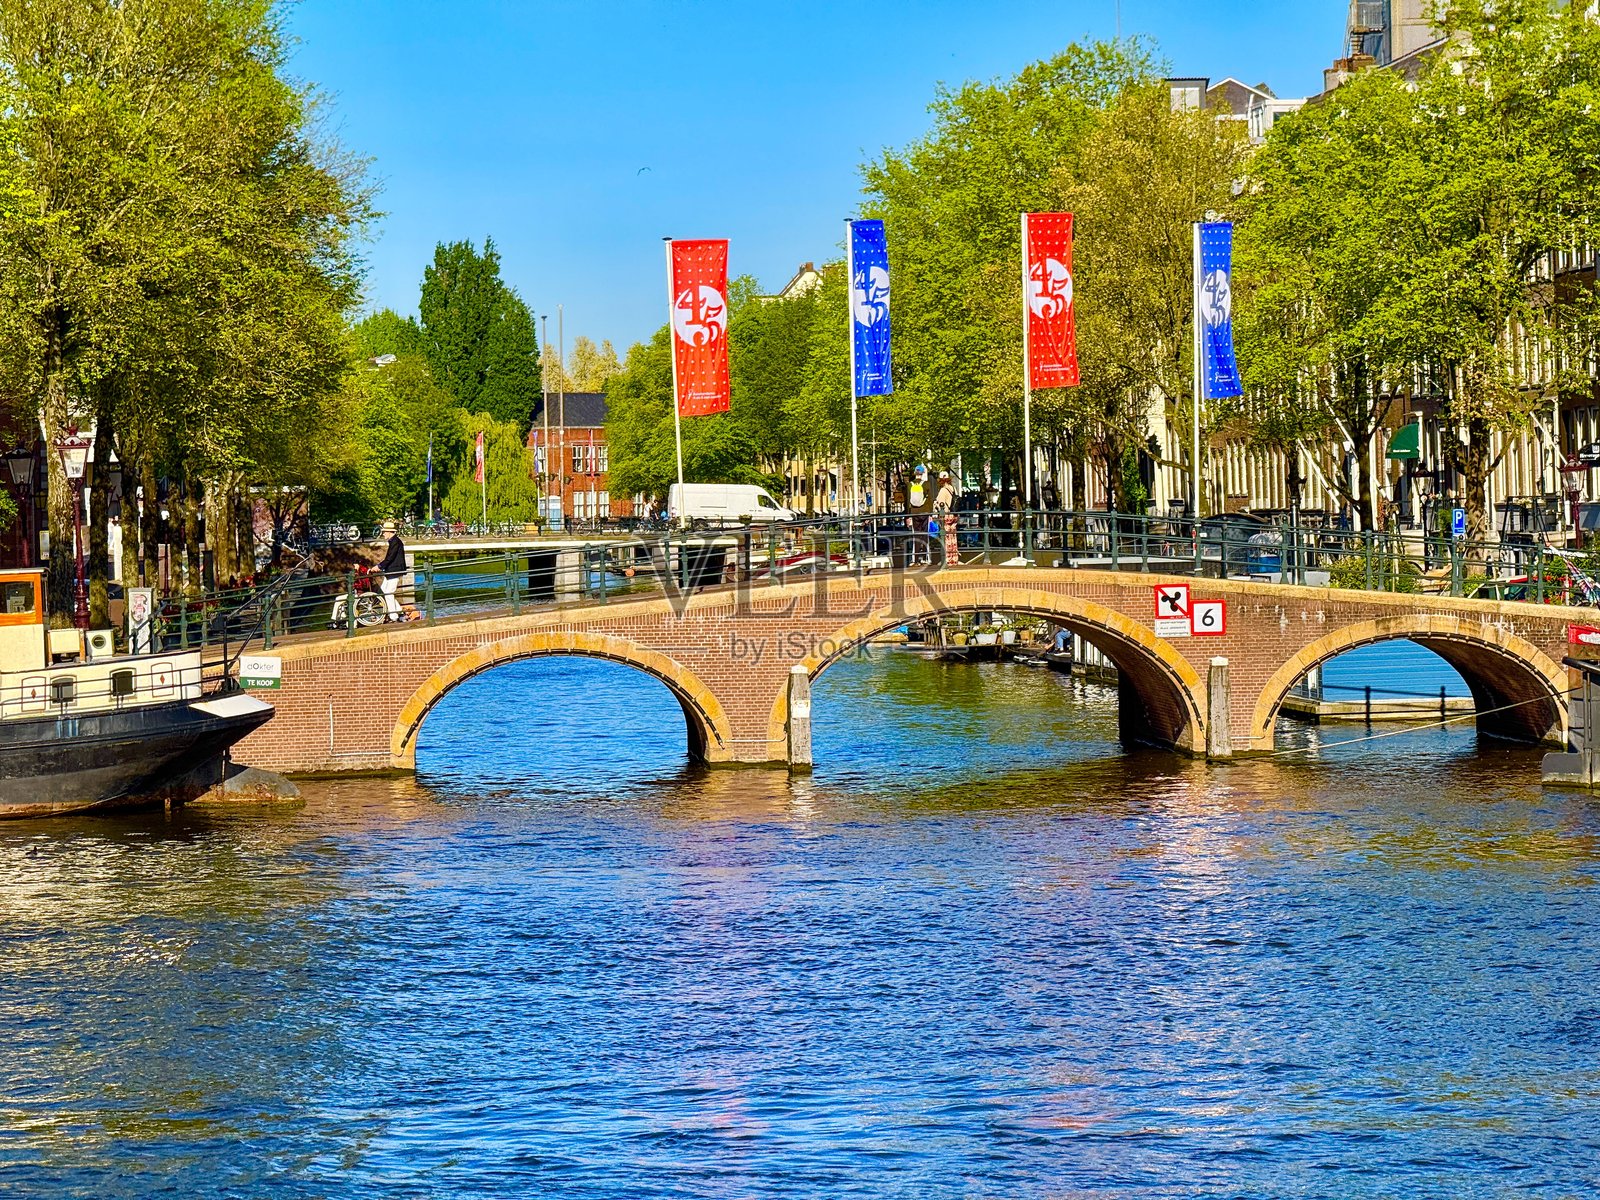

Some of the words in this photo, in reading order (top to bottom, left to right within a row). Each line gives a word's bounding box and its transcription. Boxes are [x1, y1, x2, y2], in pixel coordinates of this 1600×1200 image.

[1455, 511, 1463, 525] P
[1202, 608, 1215, 627] 6
[256, 679, 274, 687] KOOP
